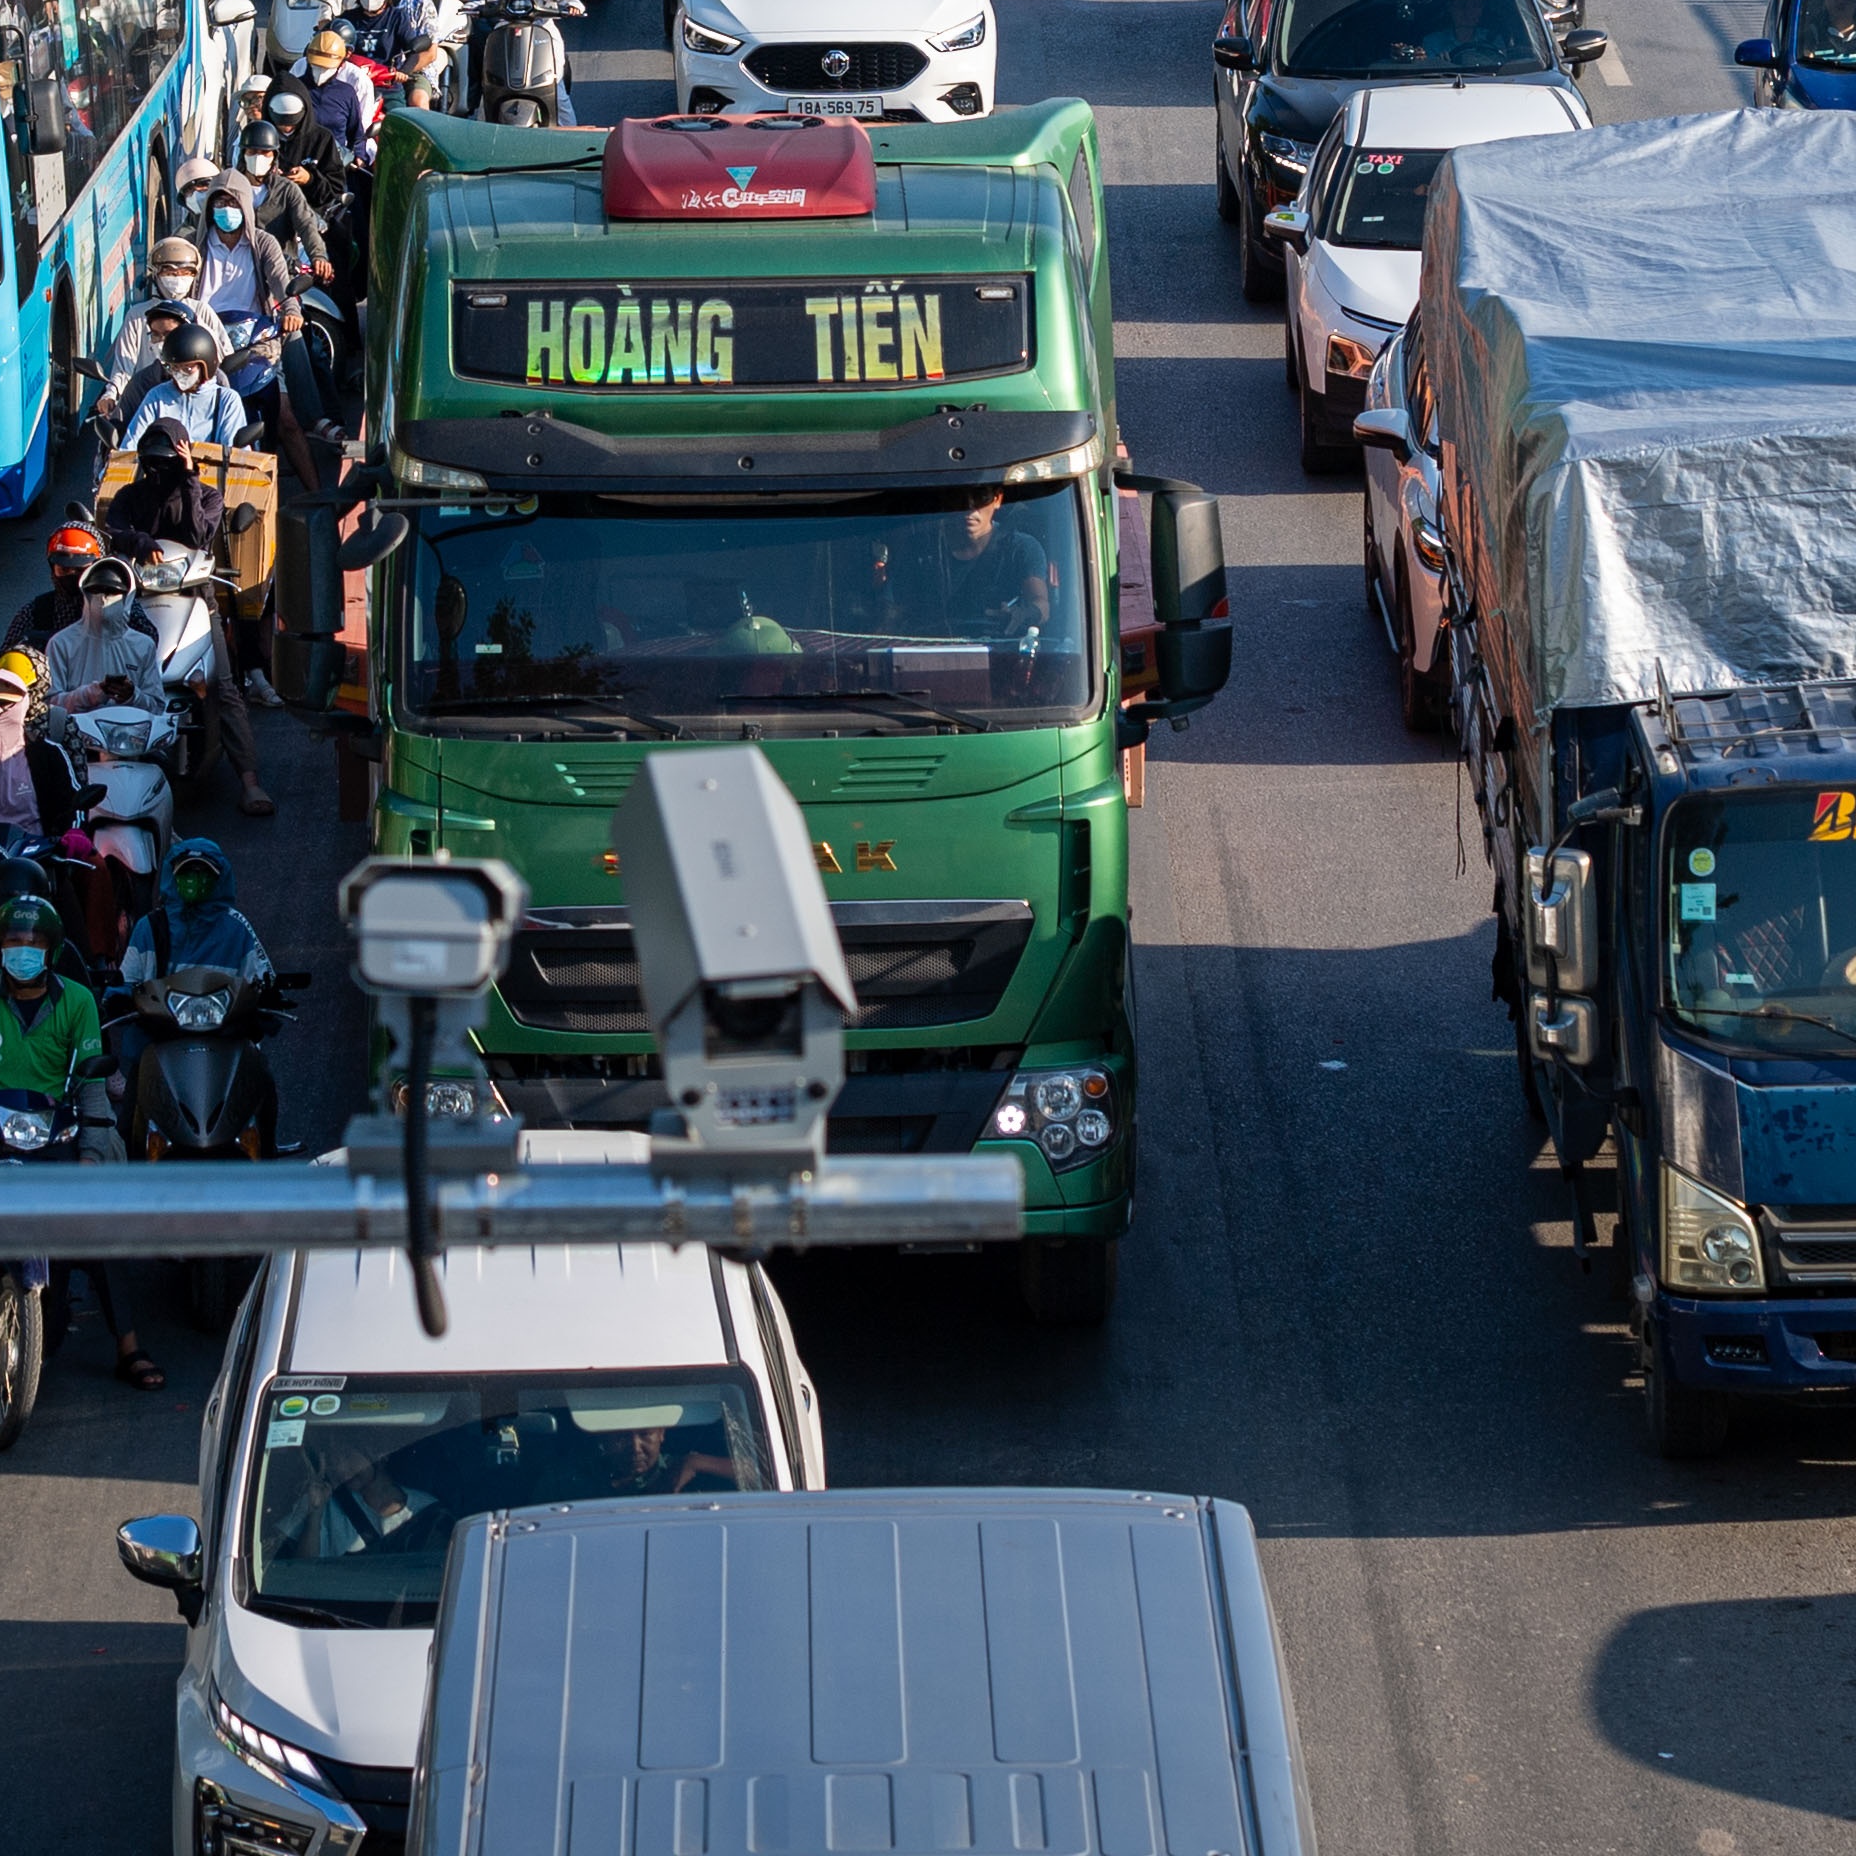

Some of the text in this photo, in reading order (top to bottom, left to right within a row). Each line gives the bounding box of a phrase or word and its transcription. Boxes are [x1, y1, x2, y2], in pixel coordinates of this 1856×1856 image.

[796, 99, 876, 116] 18A-569.75
[1368, 154, 1403, 165] TAXI
[525, 280, 944, 386] HOÀNG TIẾN
[13, 910, 40, 921] Grab
